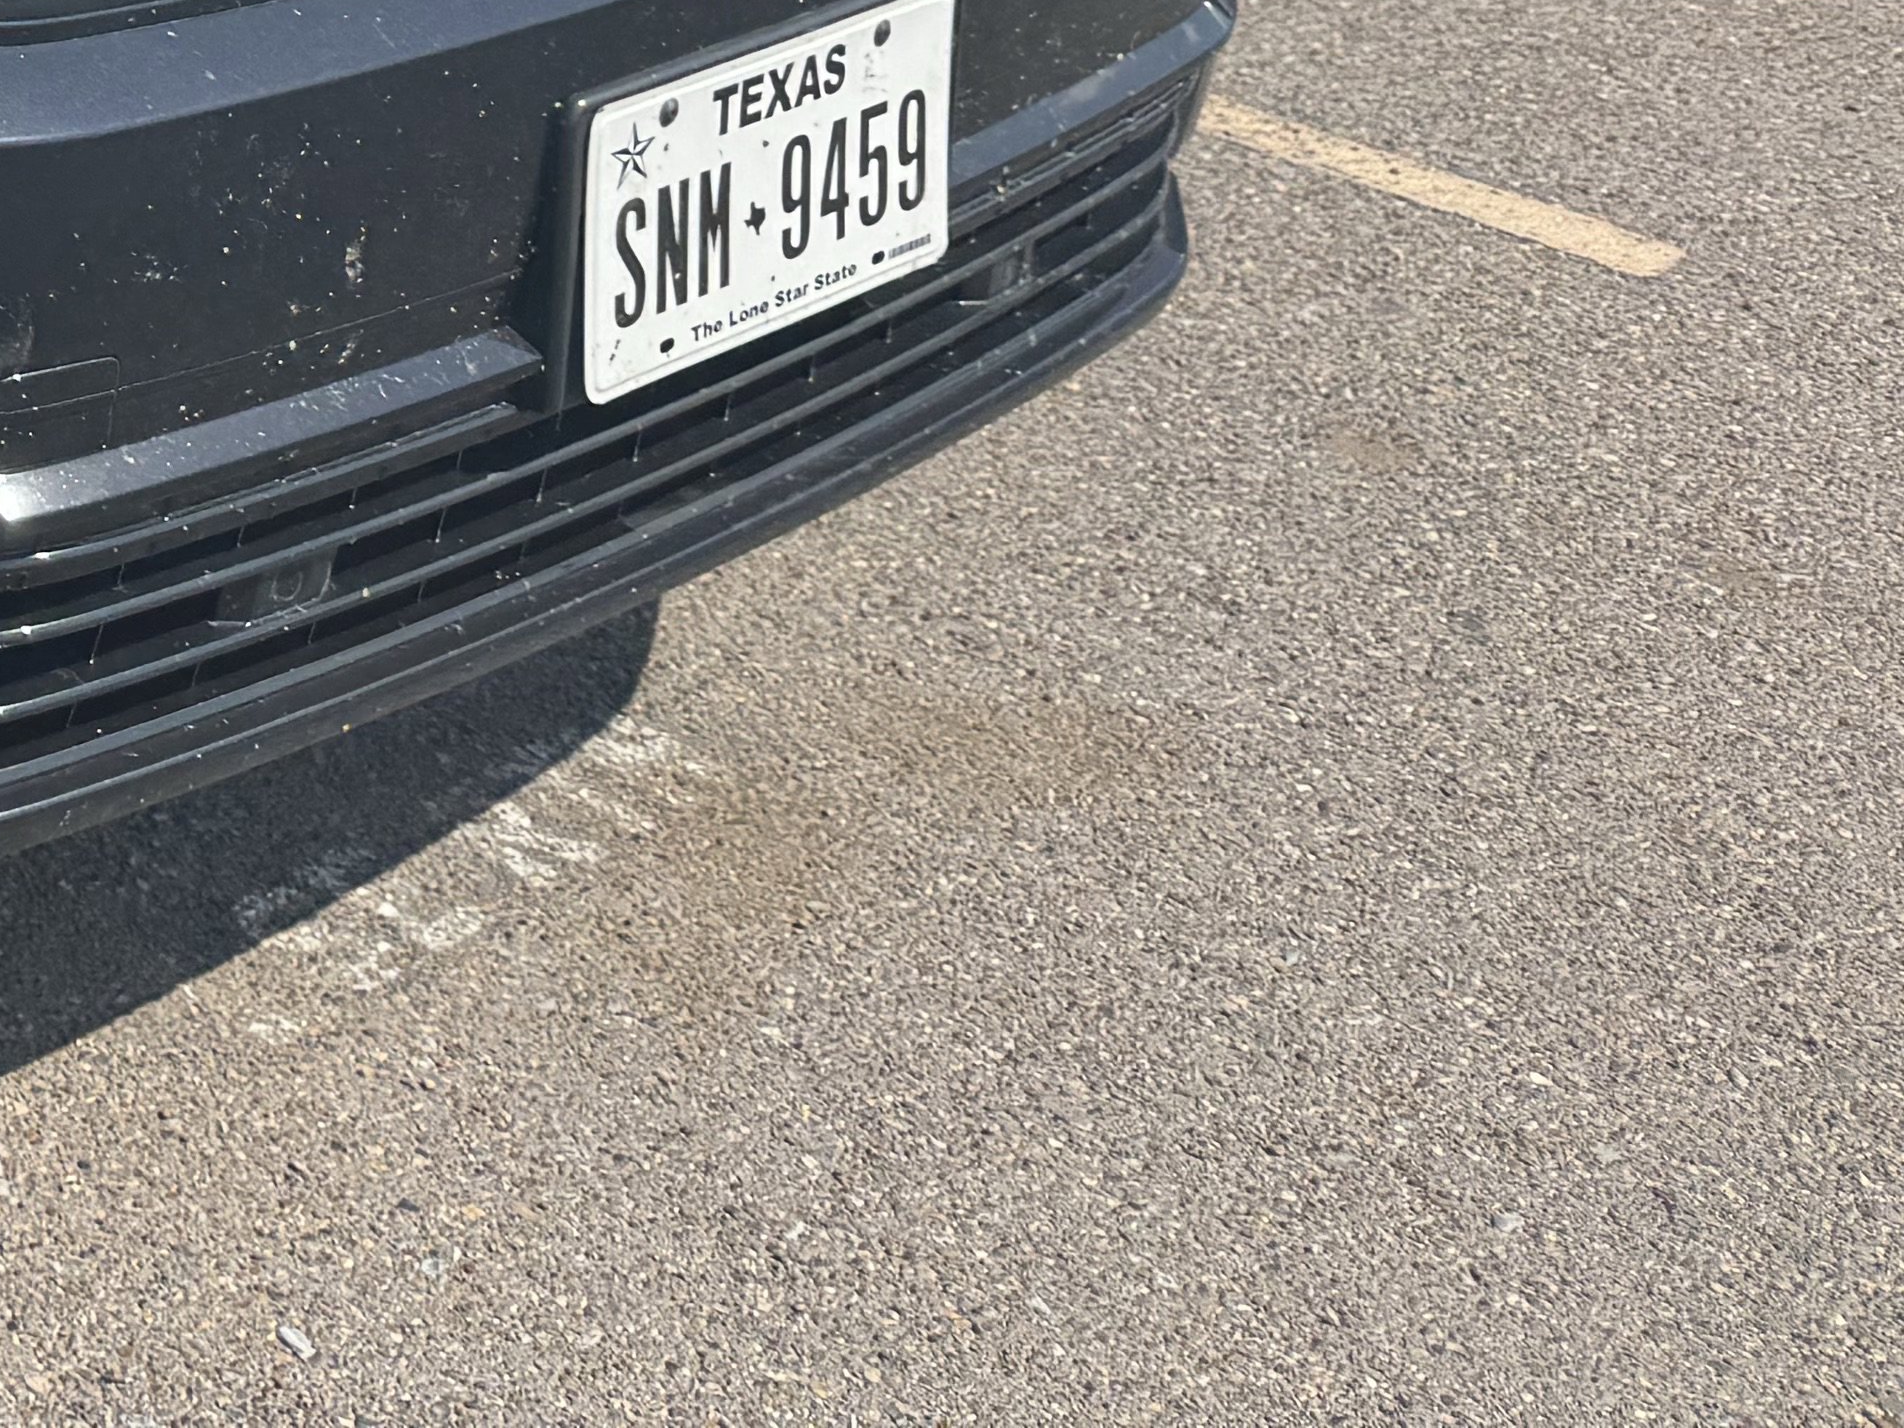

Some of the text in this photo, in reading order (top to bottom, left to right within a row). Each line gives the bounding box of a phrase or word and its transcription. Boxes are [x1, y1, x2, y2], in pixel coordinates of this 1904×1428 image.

[713, 44, 846, 136] TEXAS
[614, 89, 926, 329] SNM 9459
[691, 263, 858, 342] The Lone Star State
